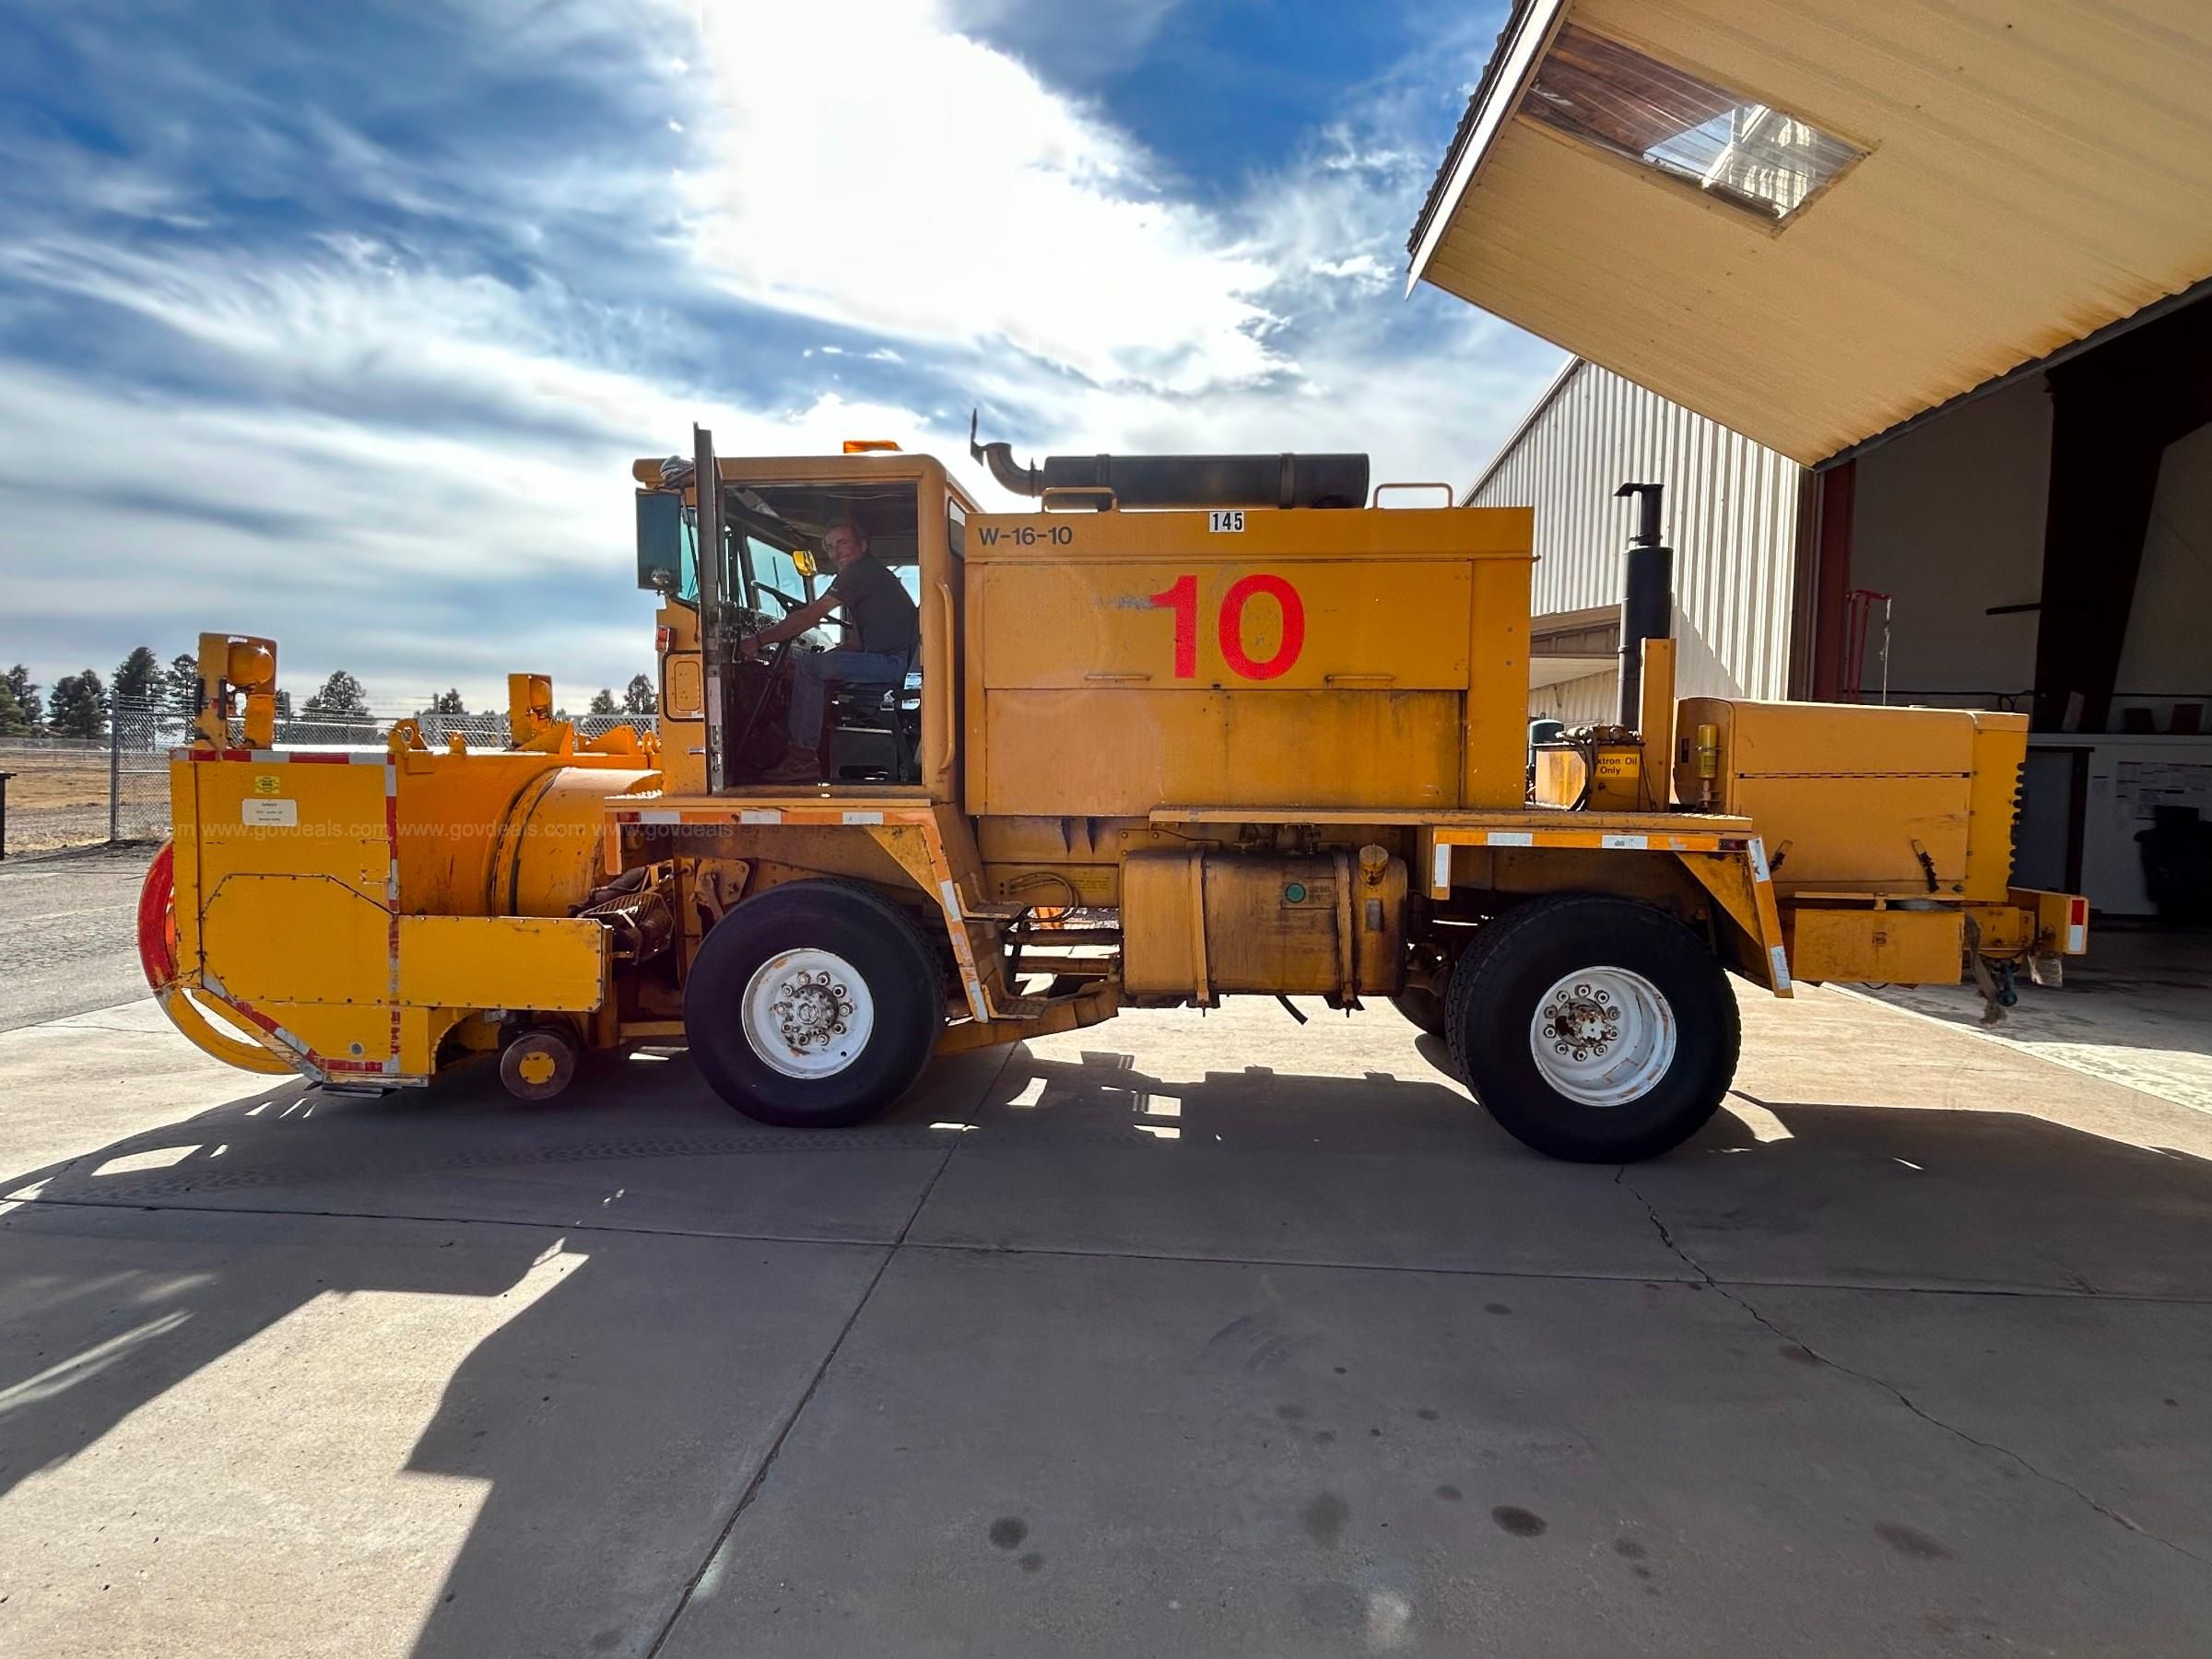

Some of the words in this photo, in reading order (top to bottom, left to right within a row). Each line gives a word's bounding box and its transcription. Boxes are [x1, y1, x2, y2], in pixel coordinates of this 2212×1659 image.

[1212, 512, 1242, 531] 145
[978, 526, 1073, 546] W-16-10
[1149, 573, 1306, 681] 10
[1597, 757, 1621, 765] xtron
[1625, 757, 1638, 765] Oil
[1600, 766, 1621, 775] Only
